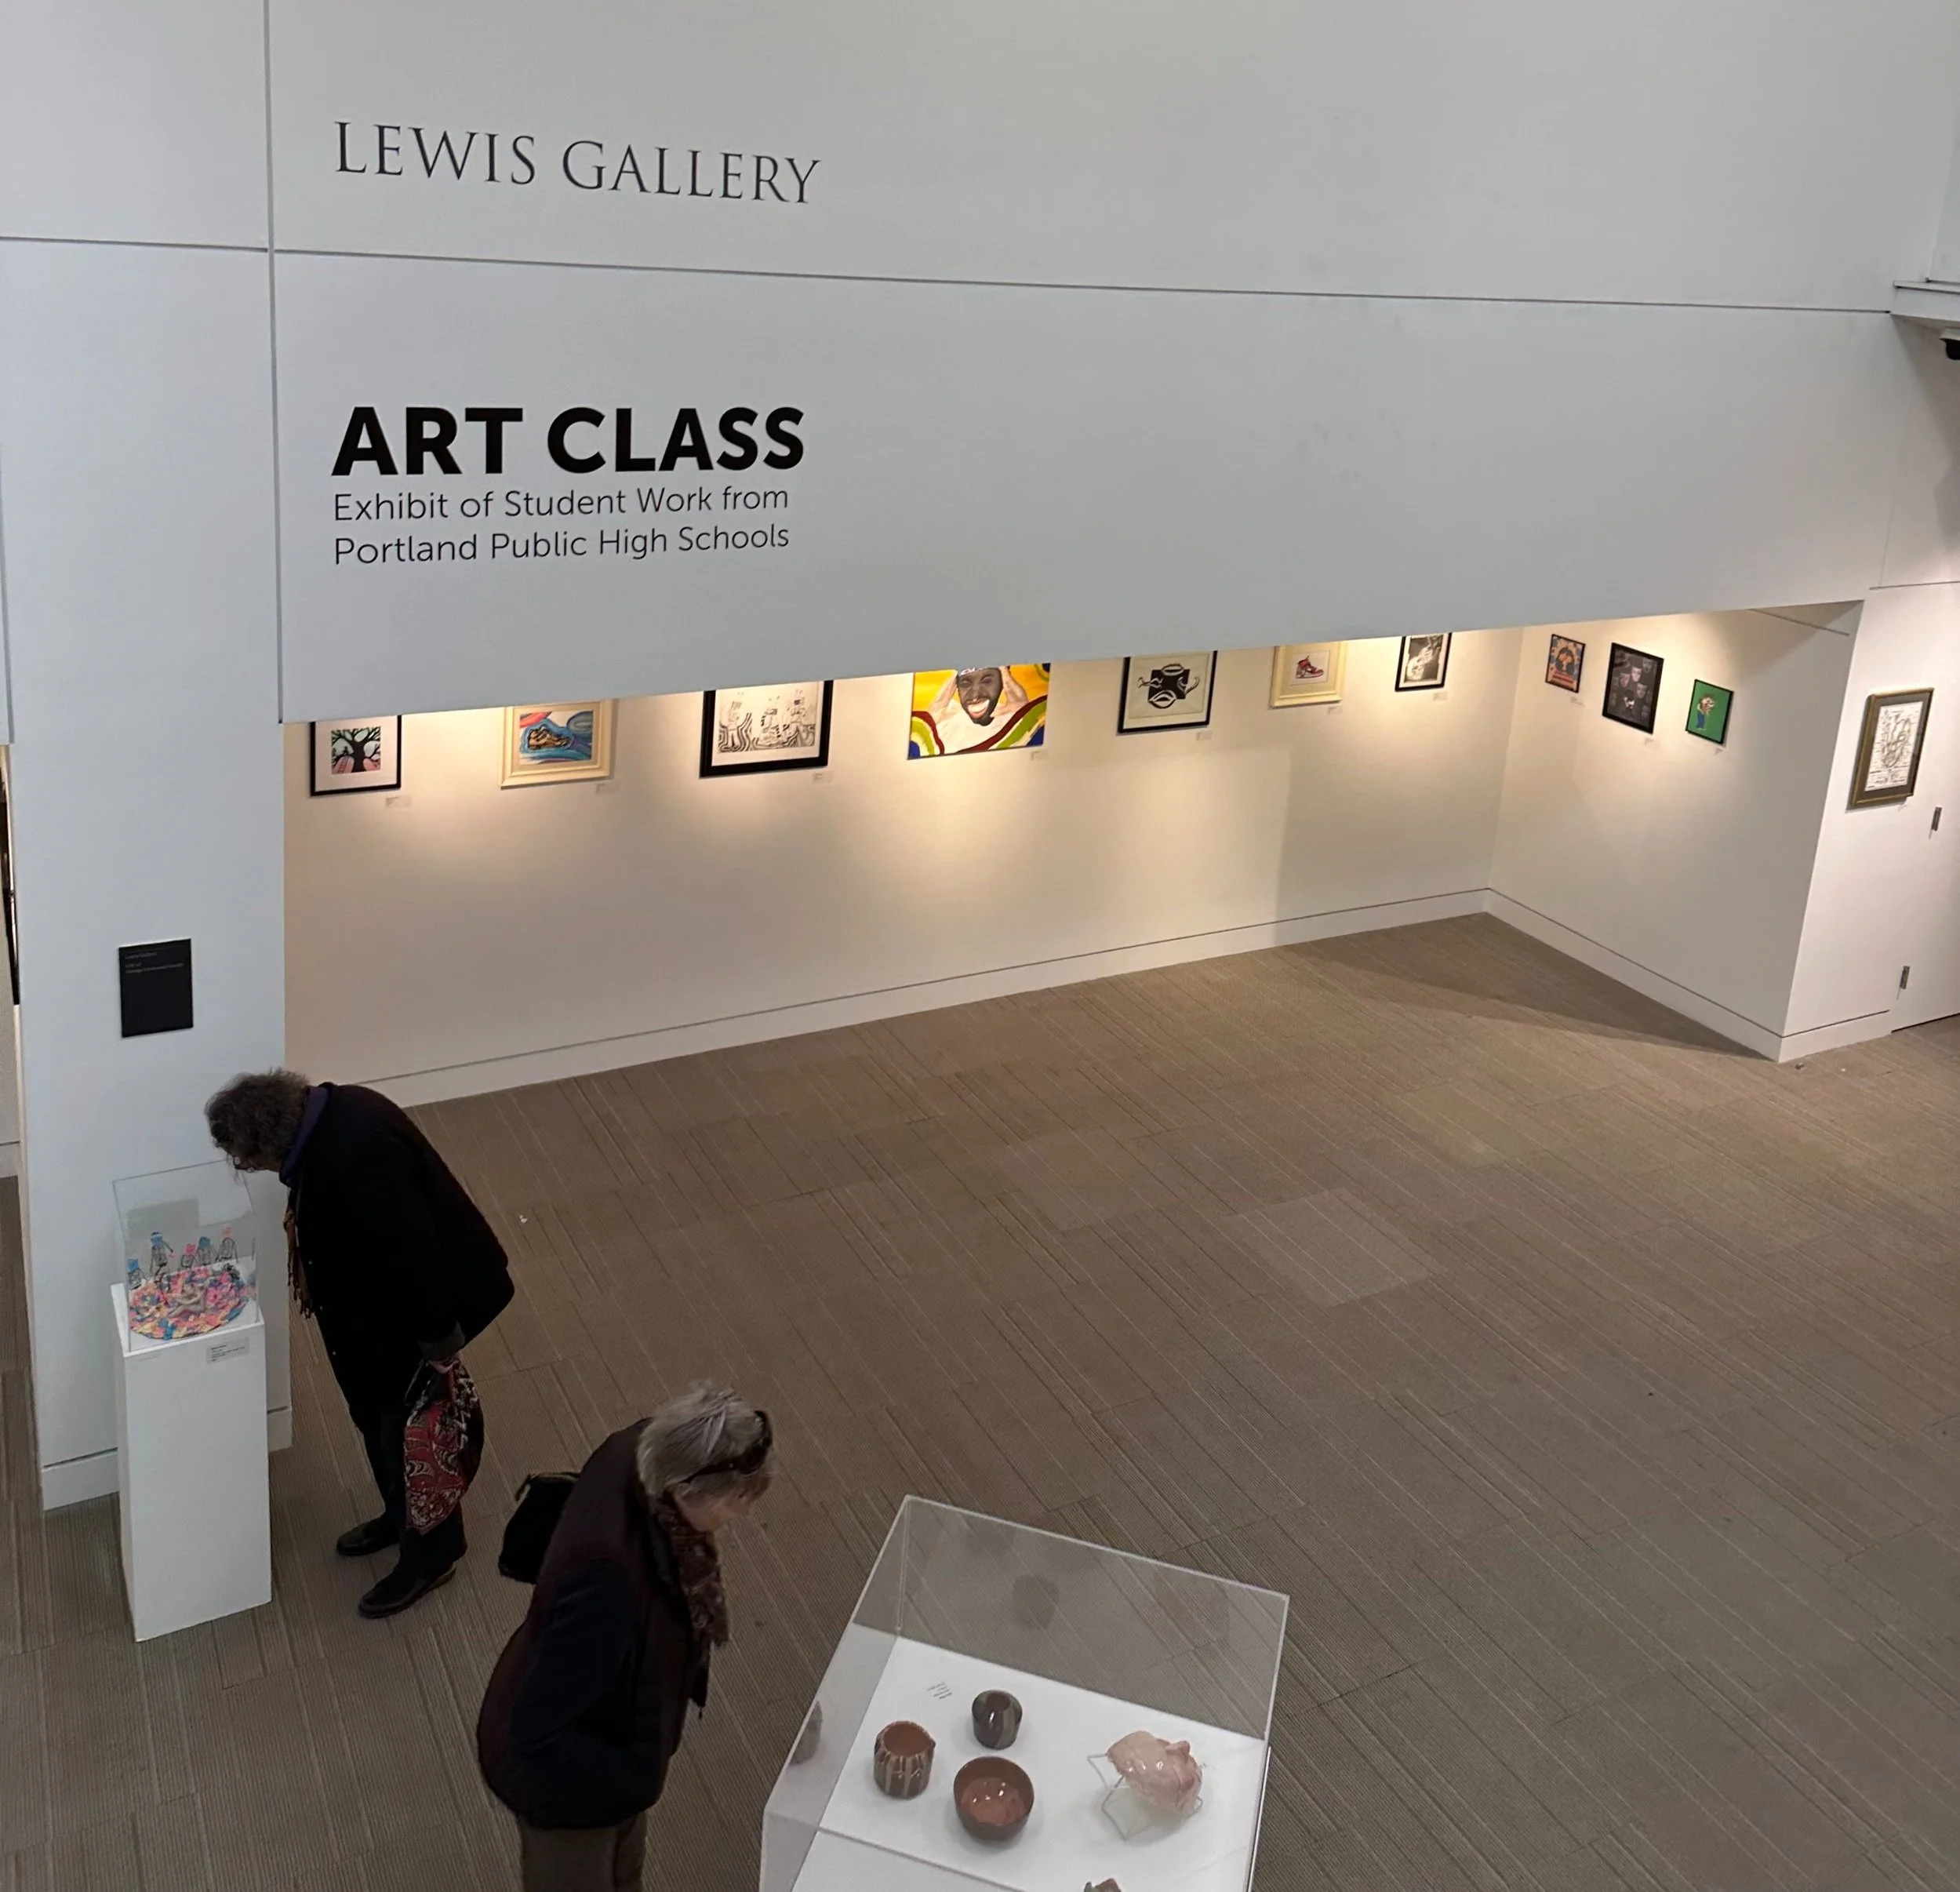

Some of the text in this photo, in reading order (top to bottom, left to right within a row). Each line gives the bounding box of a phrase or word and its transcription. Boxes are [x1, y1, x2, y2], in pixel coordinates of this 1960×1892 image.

[334, 121, 821, 204] LEWIS GALLERY
[331, 406, 805, 477] ART CLASS
[334, 485, 789, 522] Exhibit of Student Work from
[335, 522, 790, 566] Portland Public High Schools
